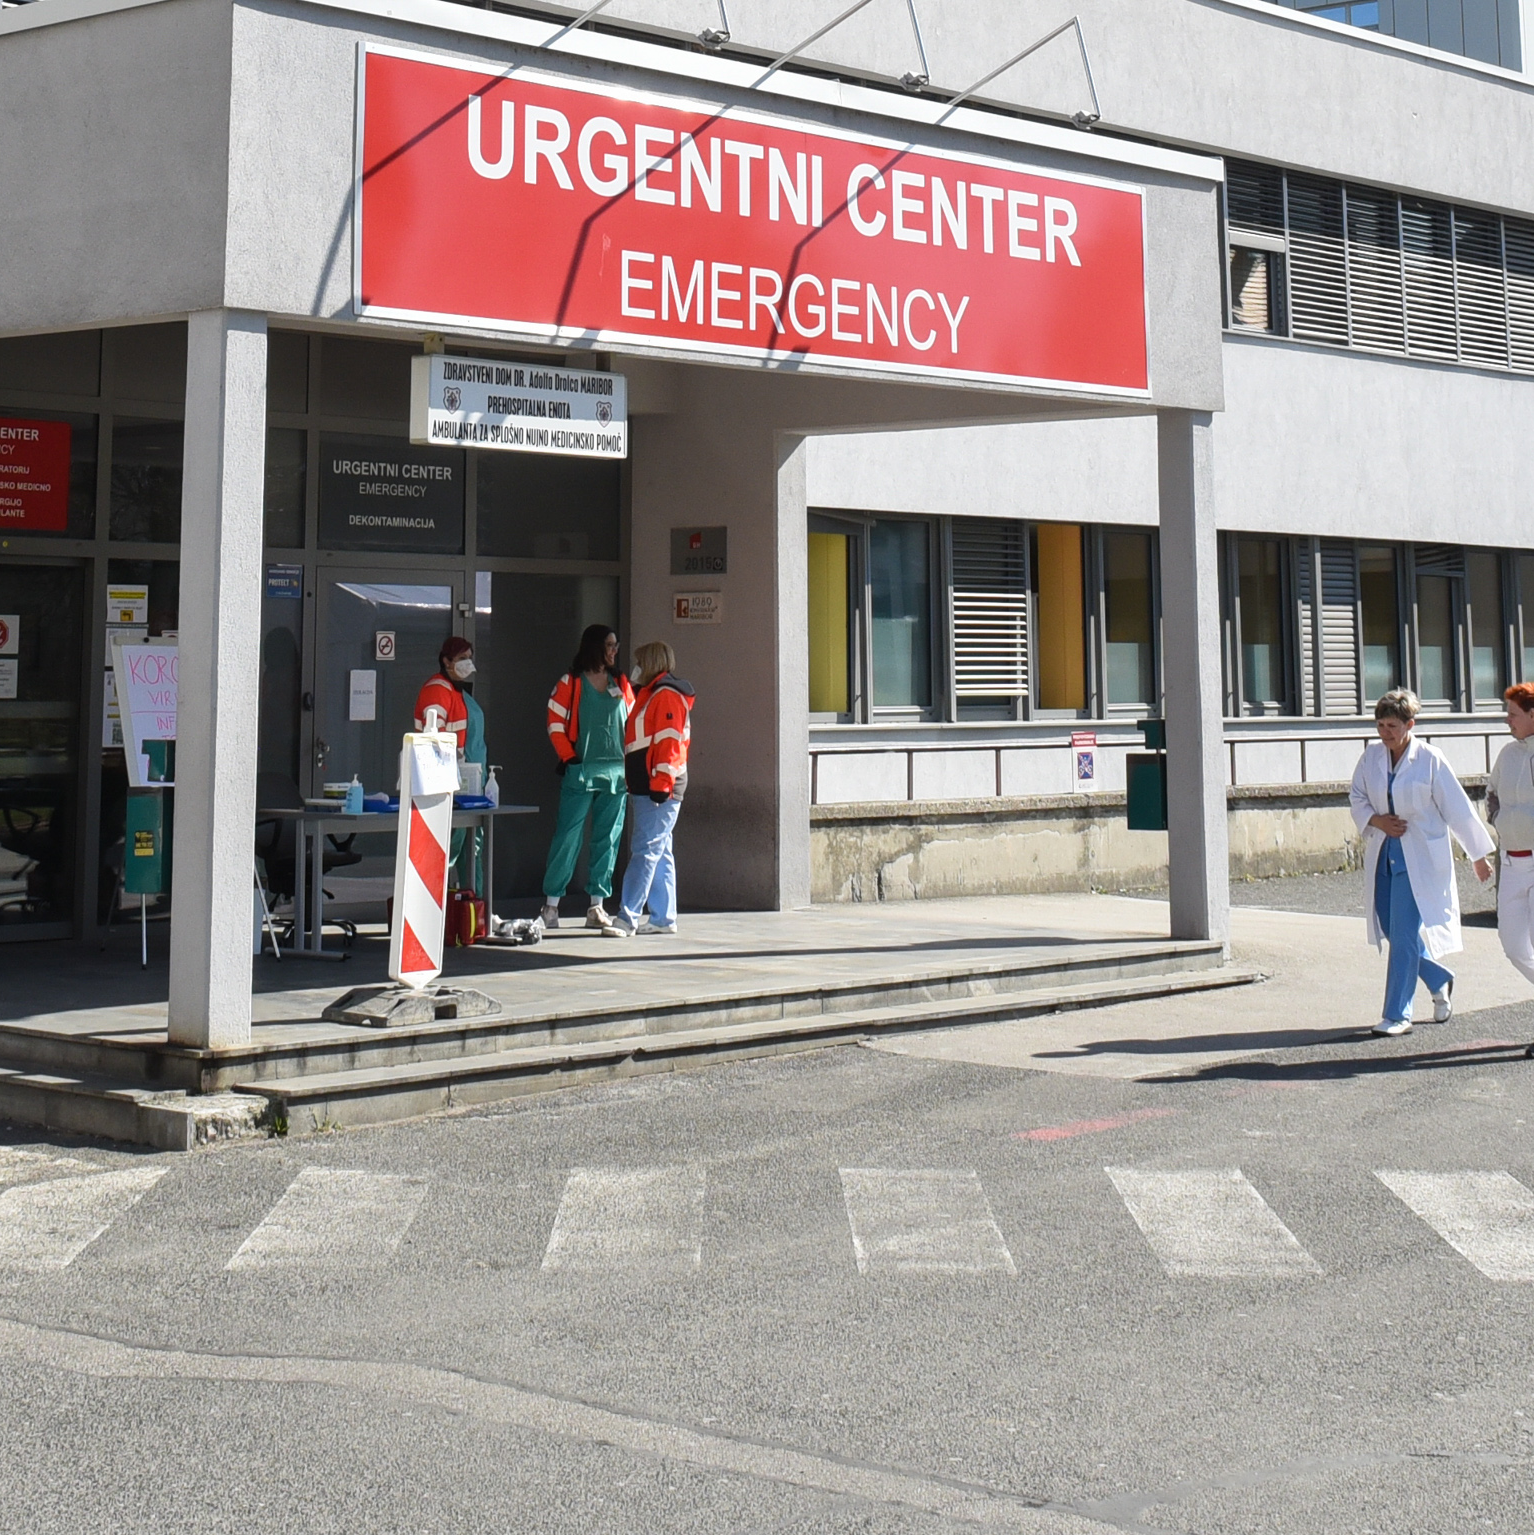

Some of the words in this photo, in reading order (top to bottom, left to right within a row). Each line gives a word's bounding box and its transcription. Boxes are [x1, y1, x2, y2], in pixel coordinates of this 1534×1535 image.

[467, 95, 823, 228] URGENTNI
[846, 163, 1082, 267] CENTER
[620, 250, 970, 353] EMERGENCY
[443, 361, 494, 384] ZDRAVSTVENI
[495, 368, 511, 386] DOM
[514, 369, 527, 387] DR.
[529, 371, 553, 390] Adolfa
[555, 374, 579, 393] Drolca
[580, 376, 613, 396] MARIBOR
[487, 395, 547, 418] PREHOSPITALNA
[548, 401, 571, 420] ENOTA
[432, 419, 478, 441] AMBULANTA
[480, 423, 489, 441] ZA
[490, 422, 524, 445] SPLOŠNO
[526, 428, 548, 447] NUJNO
[550, 430, 594, 451] MEDICINSKO
[596, 431, 622, 452] POMOČ
[332, 459, 398, 477] URGENTNI
[402, 464, 452, 481] CENTER
[359, 482, 427, 497] EMERGENCY
[348, 514, 435, 529] DEKONTAMINACIJA
[148, 690, 178, 707] VIR
